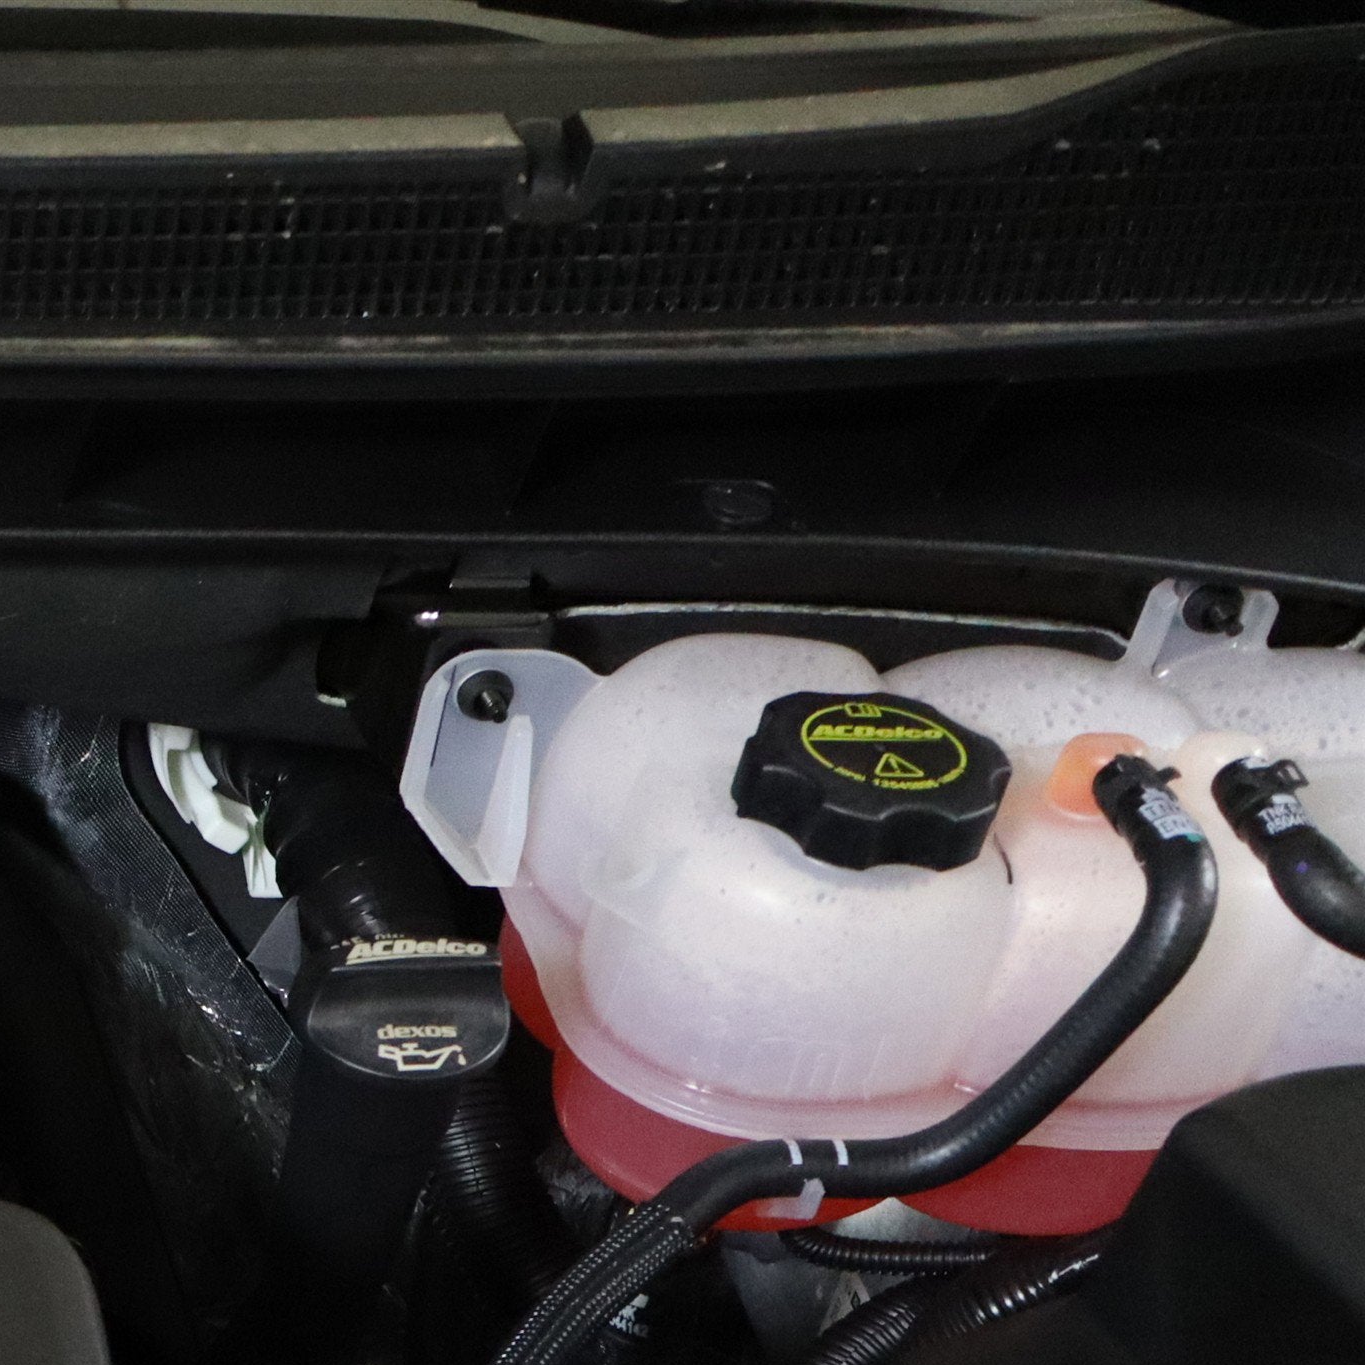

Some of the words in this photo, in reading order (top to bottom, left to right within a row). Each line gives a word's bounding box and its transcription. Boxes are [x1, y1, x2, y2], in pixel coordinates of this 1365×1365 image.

[811, 723, 946, 741] ACDelco
[346, 937, 488, 966] ACDelco
[377, 1023, 458, 1040] dexos
